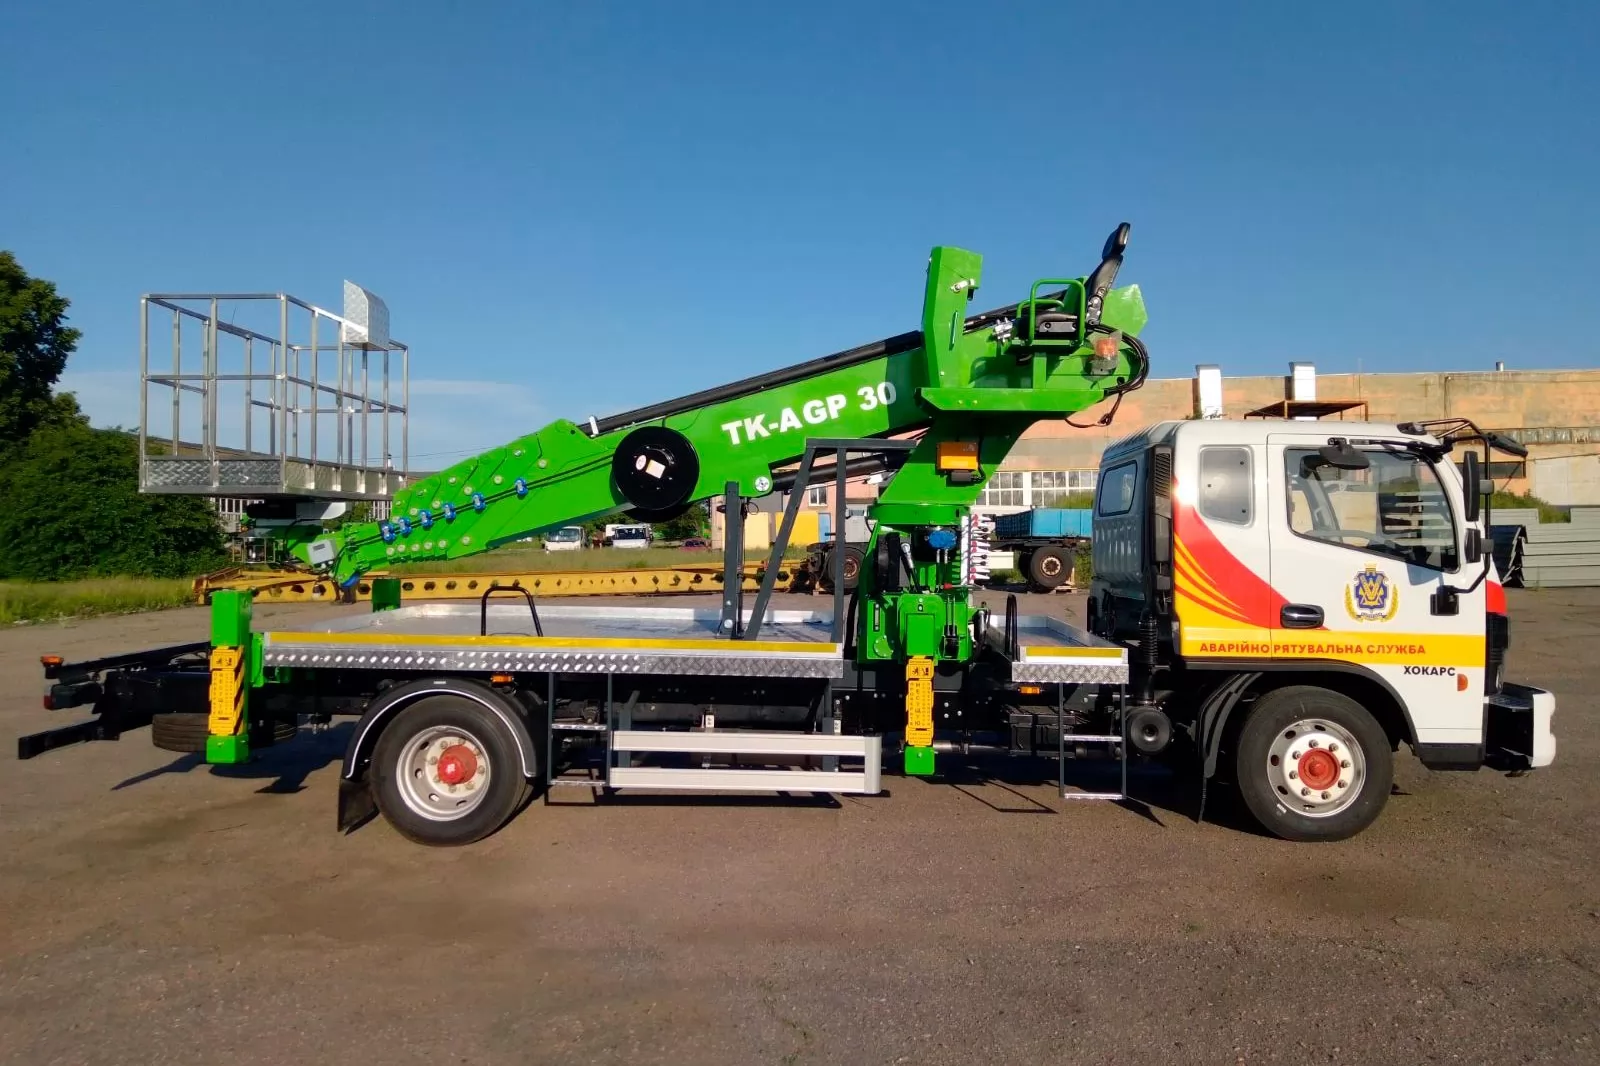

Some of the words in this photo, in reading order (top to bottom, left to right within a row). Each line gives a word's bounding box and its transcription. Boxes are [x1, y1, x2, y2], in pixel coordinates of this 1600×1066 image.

[857, 382, 896, 410] 30
[1200, 641, 1269, 654] АВАРІЙНО
[1273, 644, 1363, 655] РЯТУВАЛЬНА
[1367, 644, 1425, 655] СЛУЖБА
[1404, 665, 1455, 677] ХОКАРС
